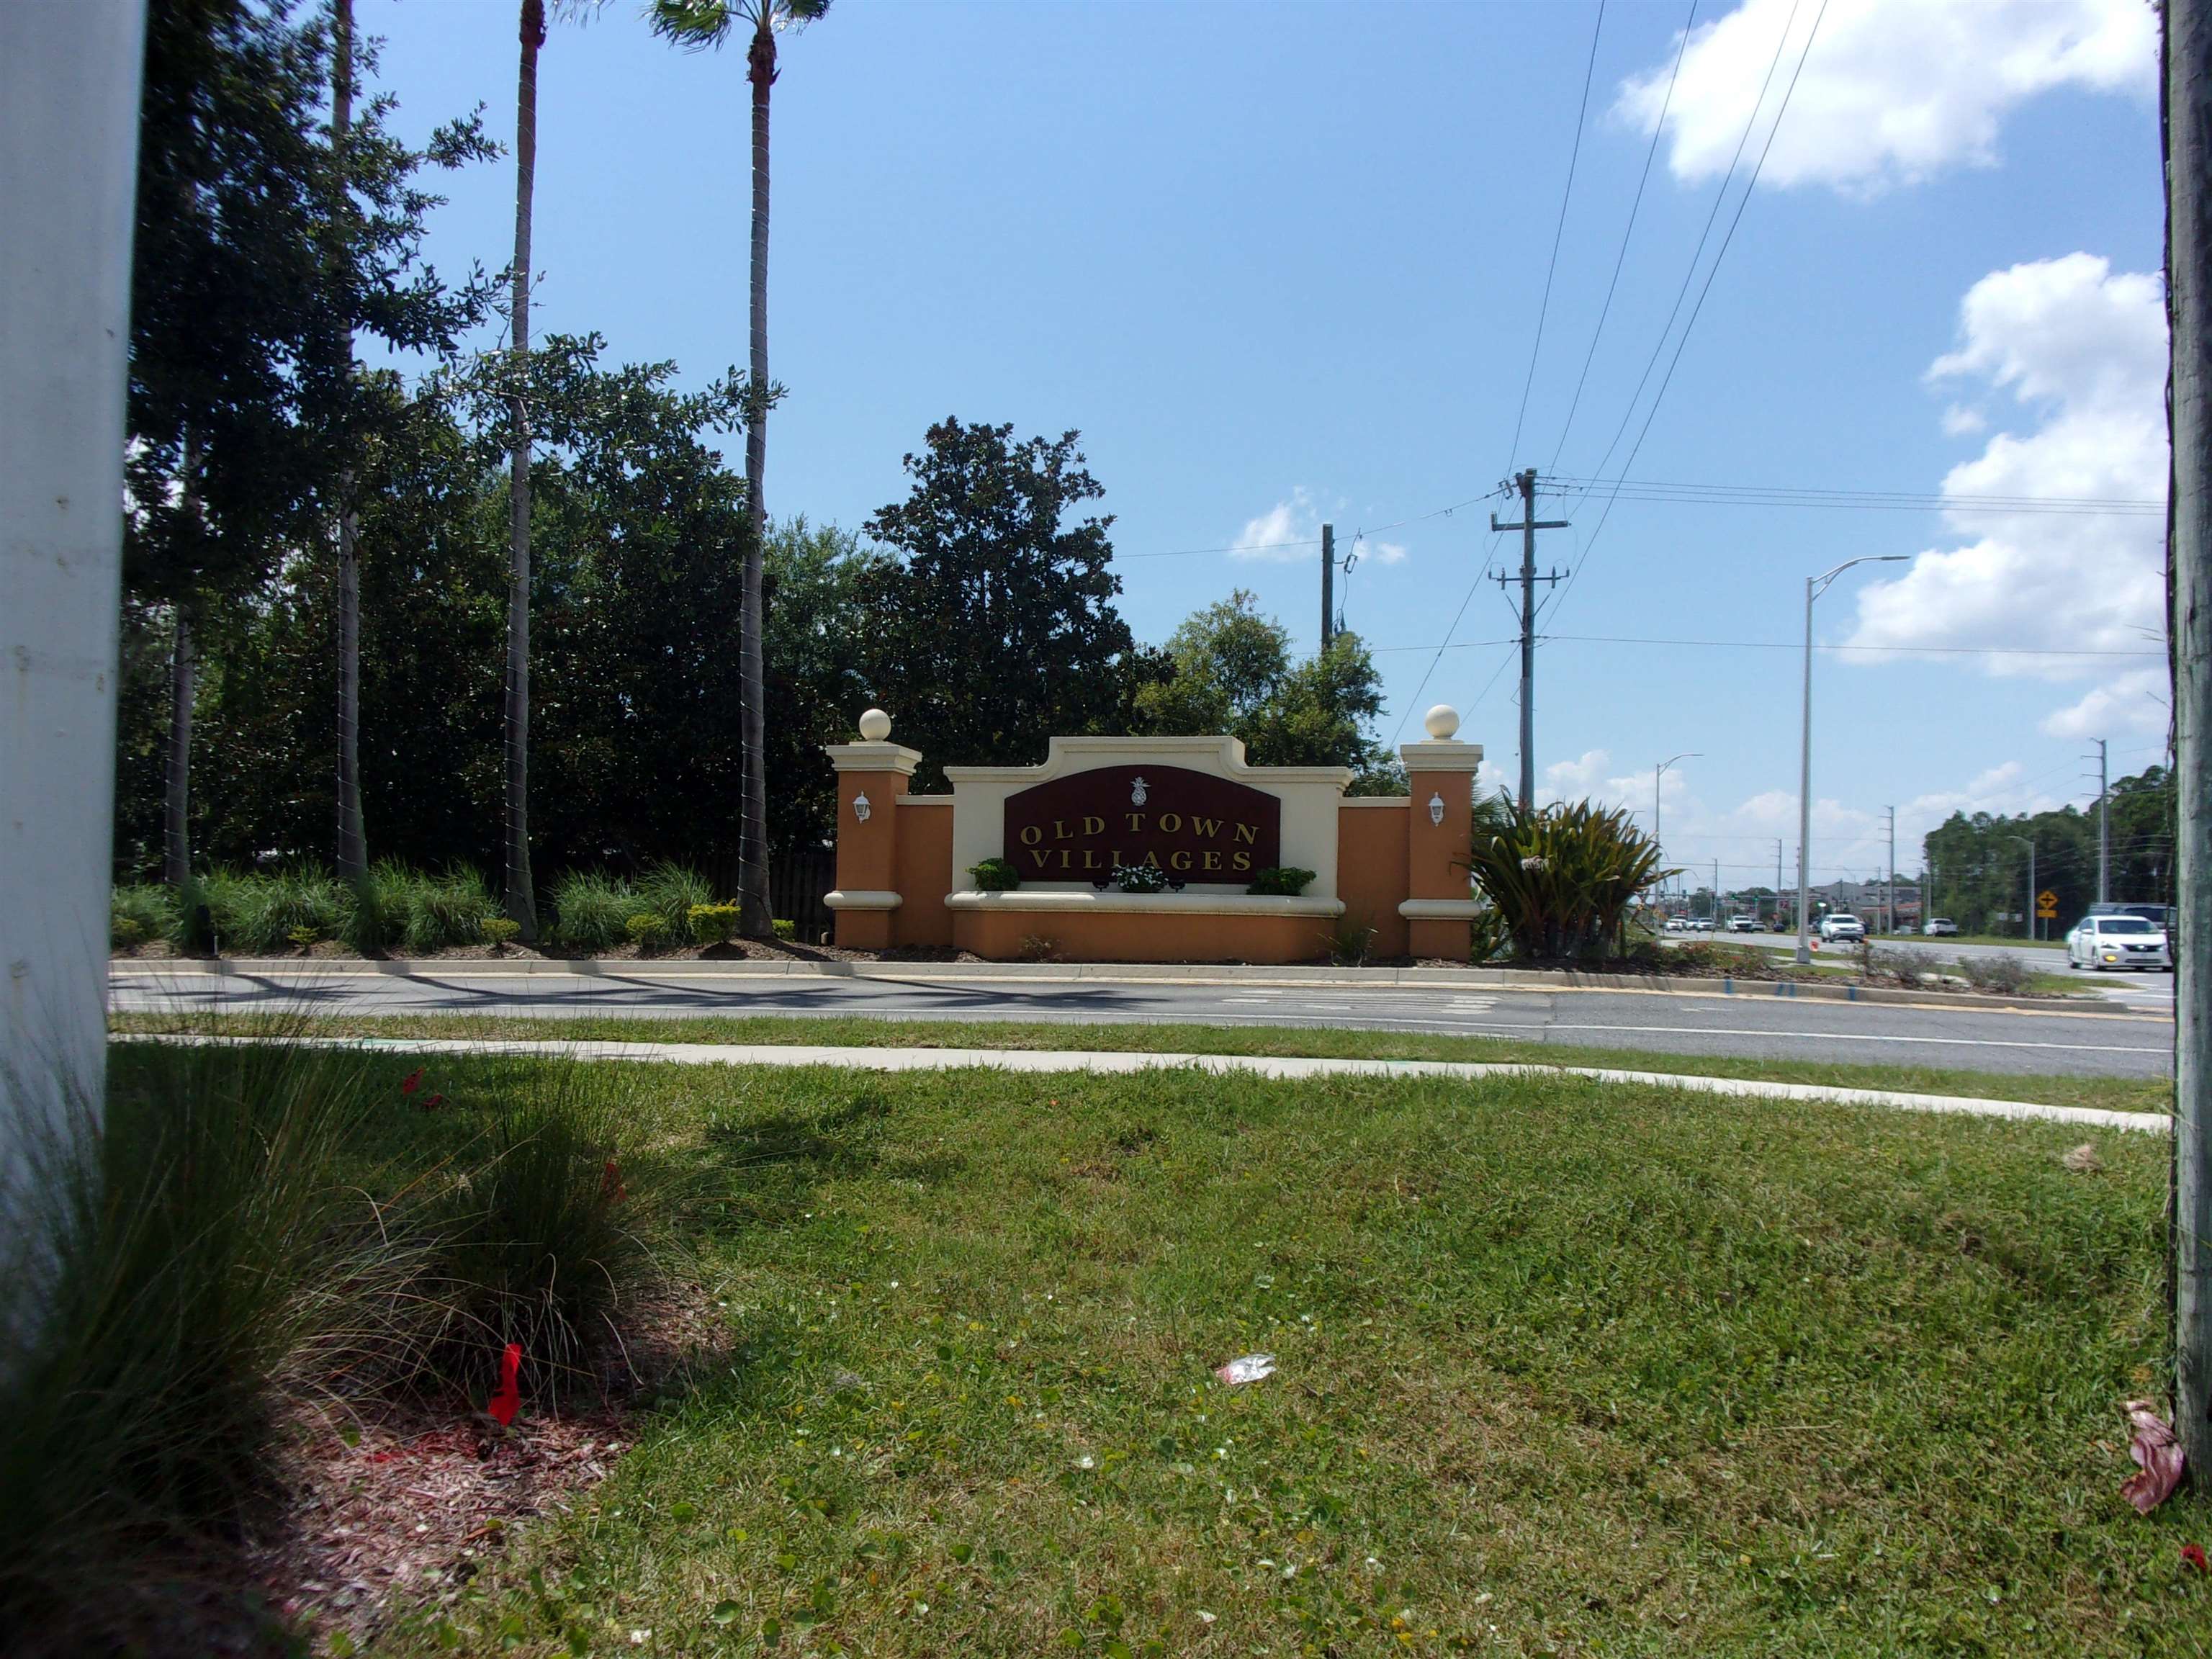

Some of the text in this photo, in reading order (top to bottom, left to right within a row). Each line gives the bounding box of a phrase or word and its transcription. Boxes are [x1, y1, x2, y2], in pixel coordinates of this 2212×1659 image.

[1020, 814, 1259, 845] OLD TOWN
[1029, 850, 1251, 871] VILLAGES
